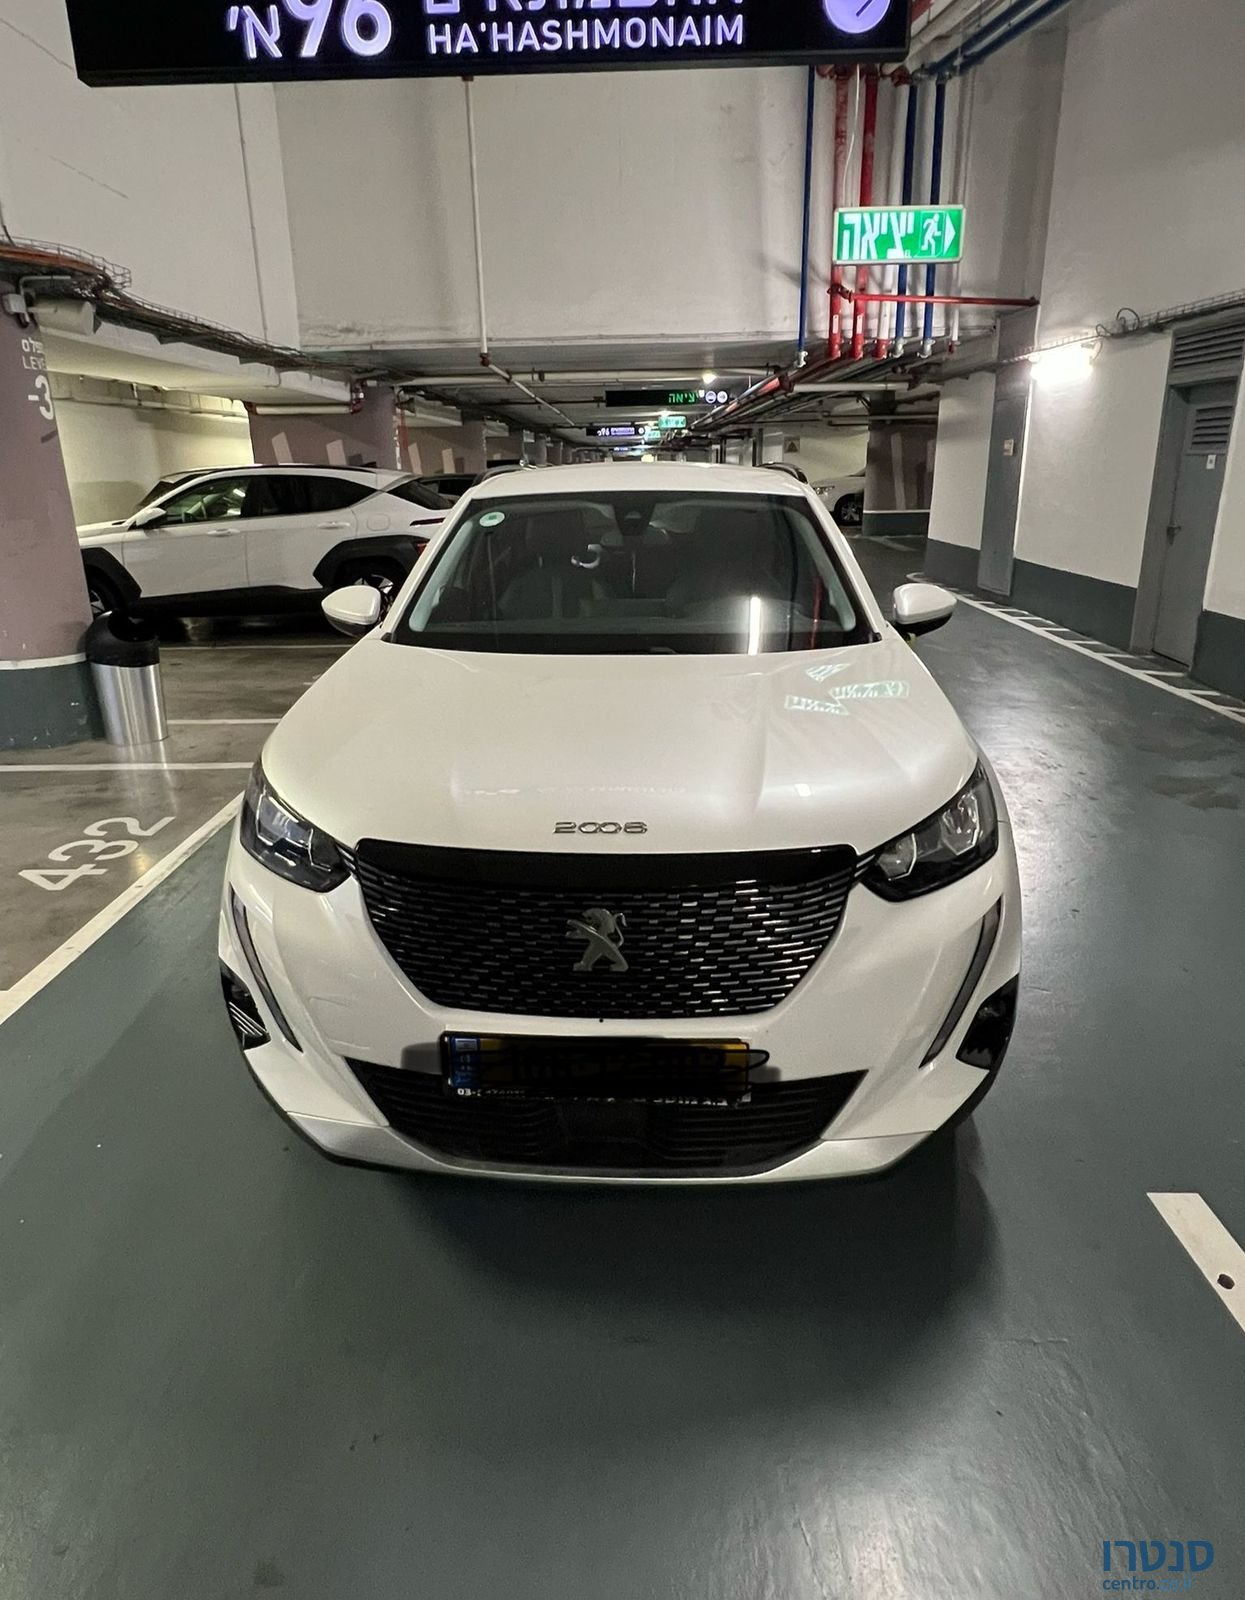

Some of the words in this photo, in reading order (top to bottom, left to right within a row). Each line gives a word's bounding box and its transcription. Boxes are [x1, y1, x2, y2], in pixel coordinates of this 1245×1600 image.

[428, 14, 744, 54] HA'HASHMONAIM
[841, 211, 915, 260] יציאה
[552, 821, 648, 834] 2008
[18, 816, 176, 891] 432
